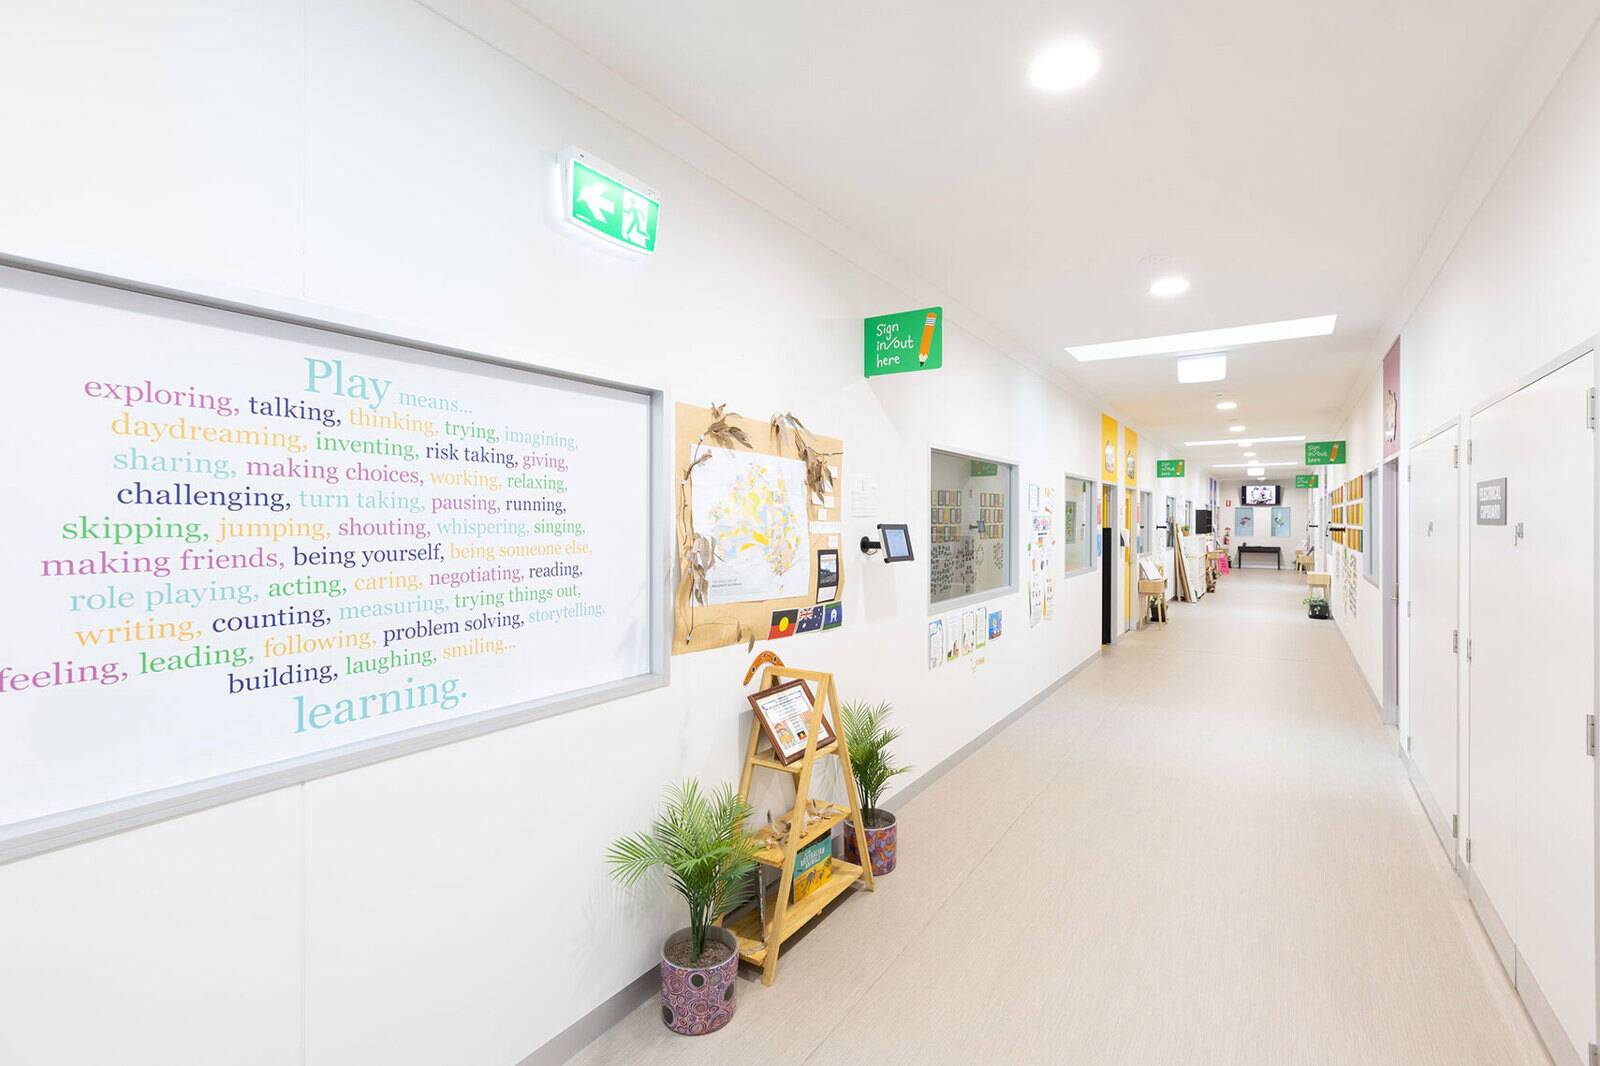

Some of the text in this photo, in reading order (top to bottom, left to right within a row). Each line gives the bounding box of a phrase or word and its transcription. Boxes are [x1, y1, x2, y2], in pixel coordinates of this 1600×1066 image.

[876, 323, 899, 341] Sign
[876, 335, 914, 351] in/out
[305, 357, 392, 409] Play
[876, 354, 900, 368] here
[83, 380, 578, 451] exploring, talking, thinking, trying, imagining,
[111, 411, 568, 472] daydreaming, inventing, risk taking, giving,
[113, 447, 567, 494] sharing, making choices, working, relaxing,
[117, 481, 566, 516] challenging, turn taking, pausing, running,
[62, 516, 585, 543] skipping, jumping, shouting, whispering, singing,
[40, 540, 592, 577] making friends, being yourself, being someone else,
[70, 560, 583, 612] role playing, acting, caring, negotiating, reading,
[74, 584, 582, 646] writing, counting, measuring, trying things out,
[0, 602, 605, 693] feeling, leading, following, problem solving, storytelling,
[228, 666, 339, 694] building,
[344, 648, 437, 676] laughing,
[292, 679, 467, 734] learning.
